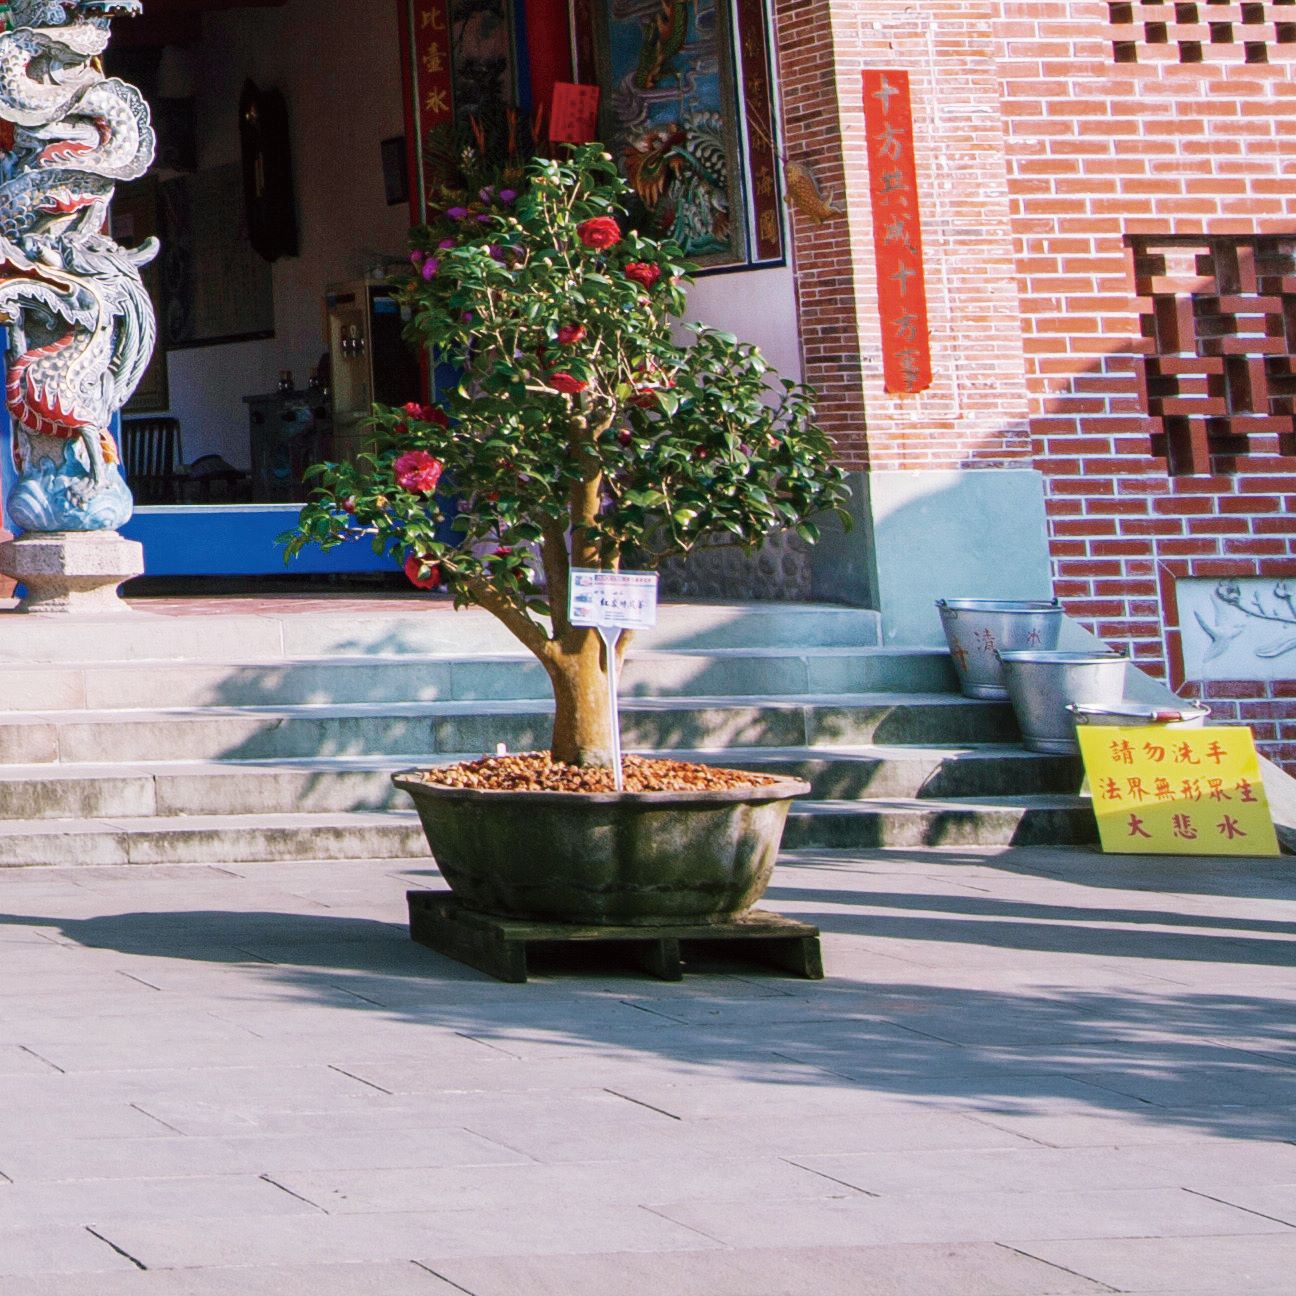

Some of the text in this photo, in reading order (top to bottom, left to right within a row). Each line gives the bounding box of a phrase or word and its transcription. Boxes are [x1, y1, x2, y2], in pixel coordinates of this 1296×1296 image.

[1109, 740, 1228, 765] 請勿洗手
[1099, 777, 1258, 803] 法界無形眾生
[1127, 813, 1247, 840] 大悲水
